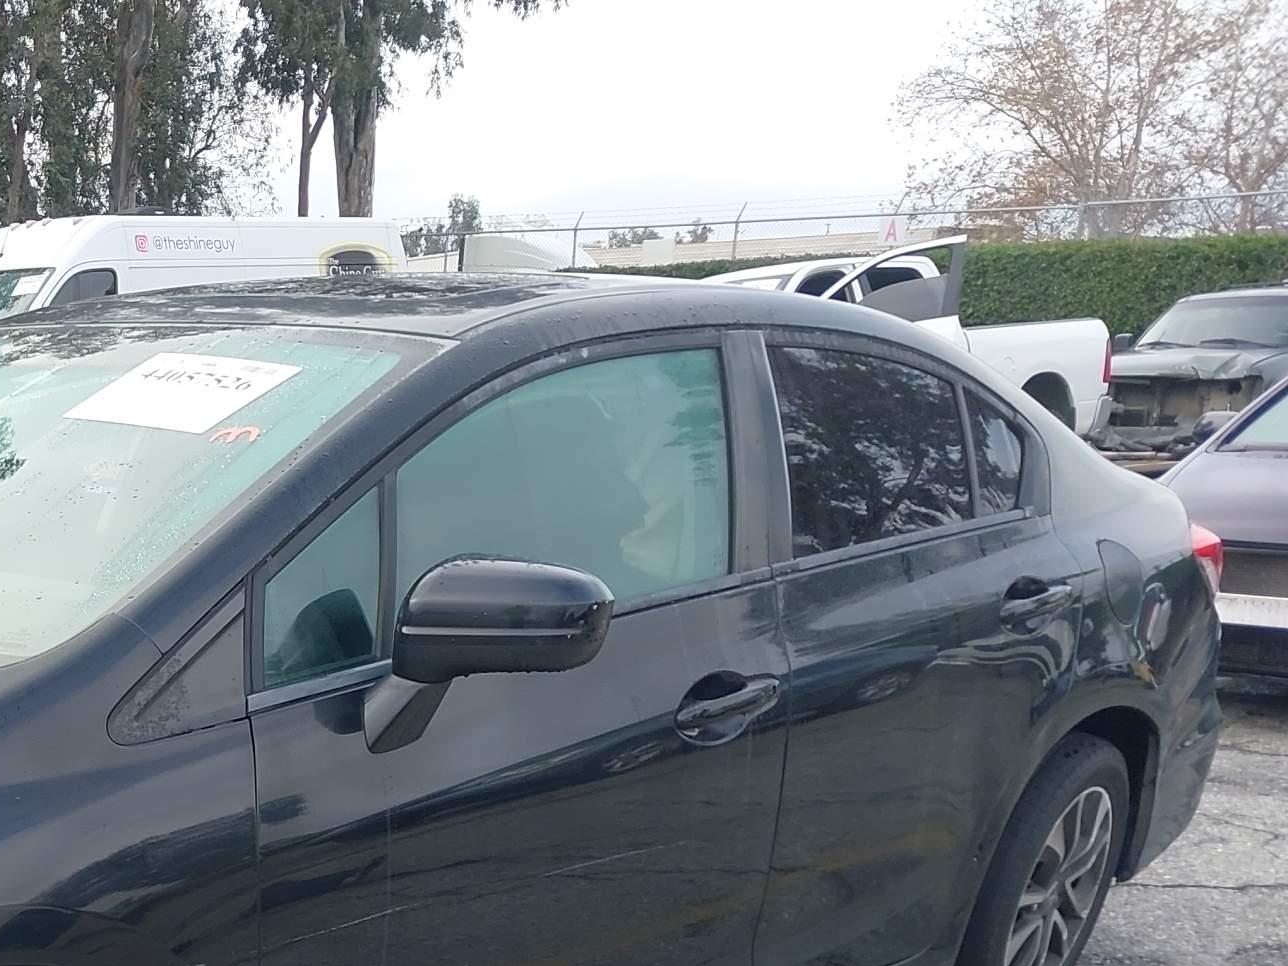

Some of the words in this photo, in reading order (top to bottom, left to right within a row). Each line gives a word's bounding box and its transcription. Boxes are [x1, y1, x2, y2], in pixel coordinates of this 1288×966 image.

[884, 217, 897, 242] A
[152, 235, 236, 253] @theshineguy
[328, 257, 339, 265] The
